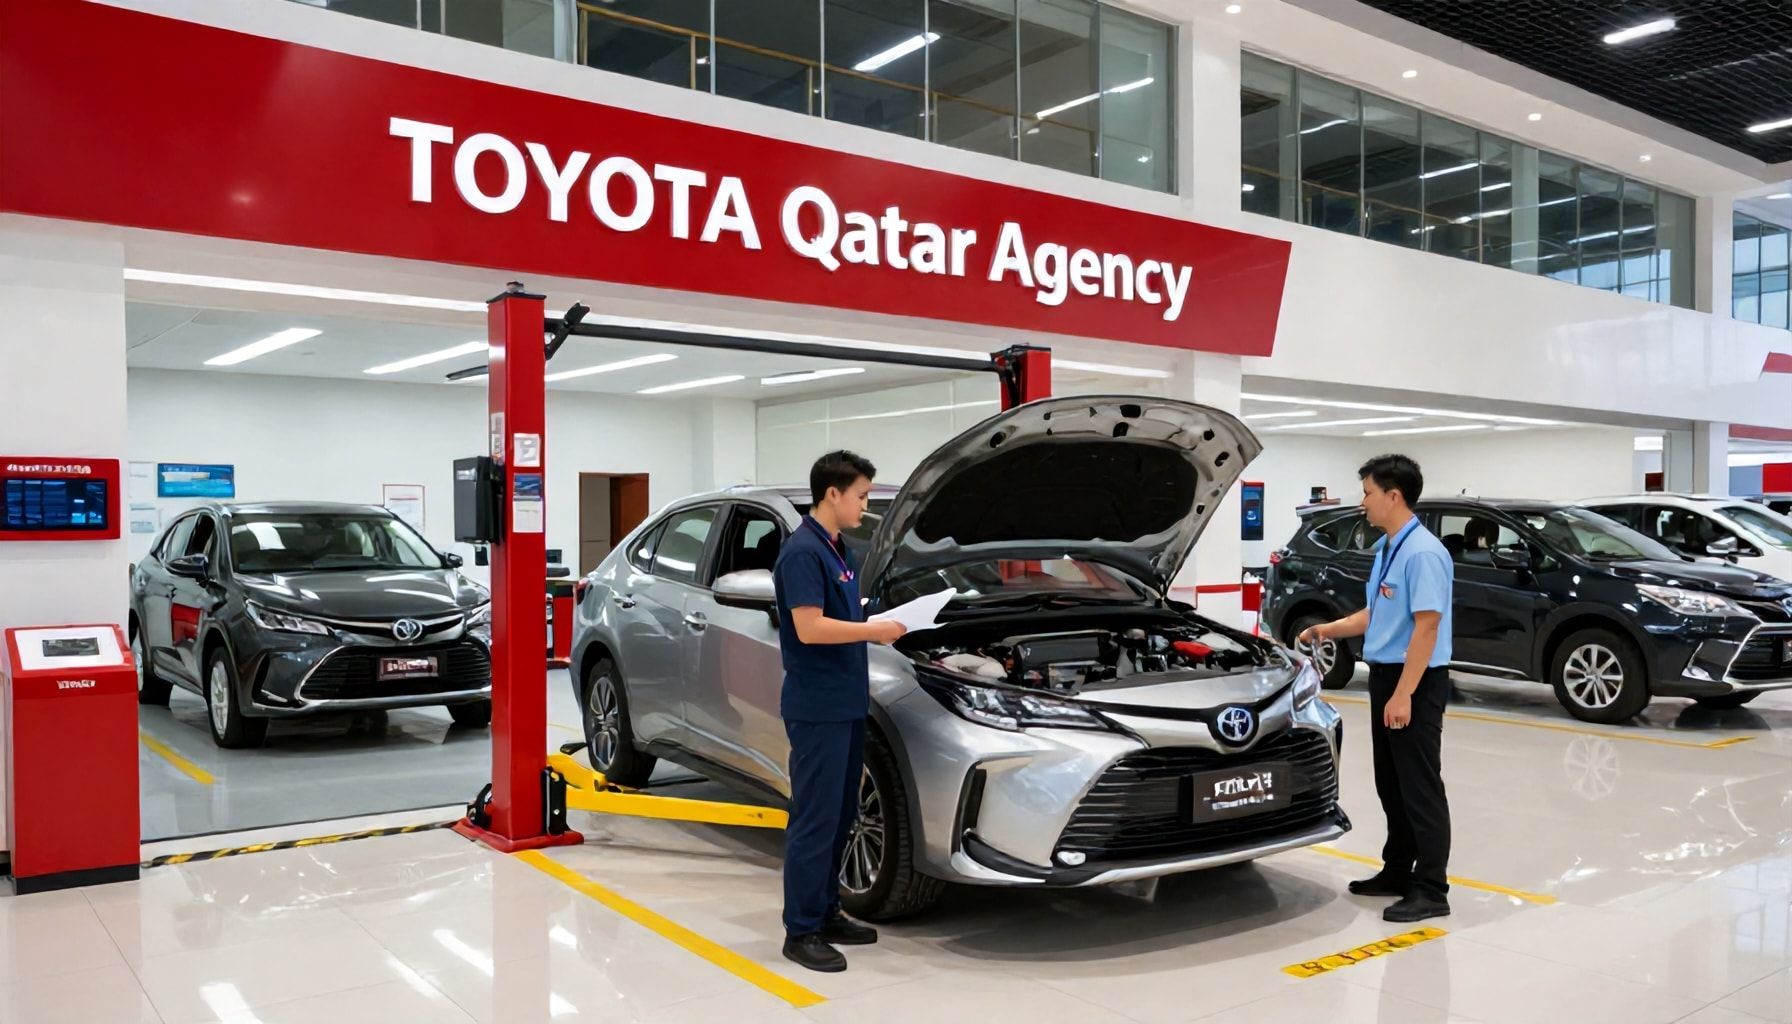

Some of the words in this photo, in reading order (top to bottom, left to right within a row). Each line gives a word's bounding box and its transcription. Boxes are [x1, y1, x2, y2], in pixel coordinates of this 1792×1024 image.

[388, 116, 762, 251] TOYOTA
[780, 185, 977, 278] Qatar
[987, 221, 1194, 322] Agency
